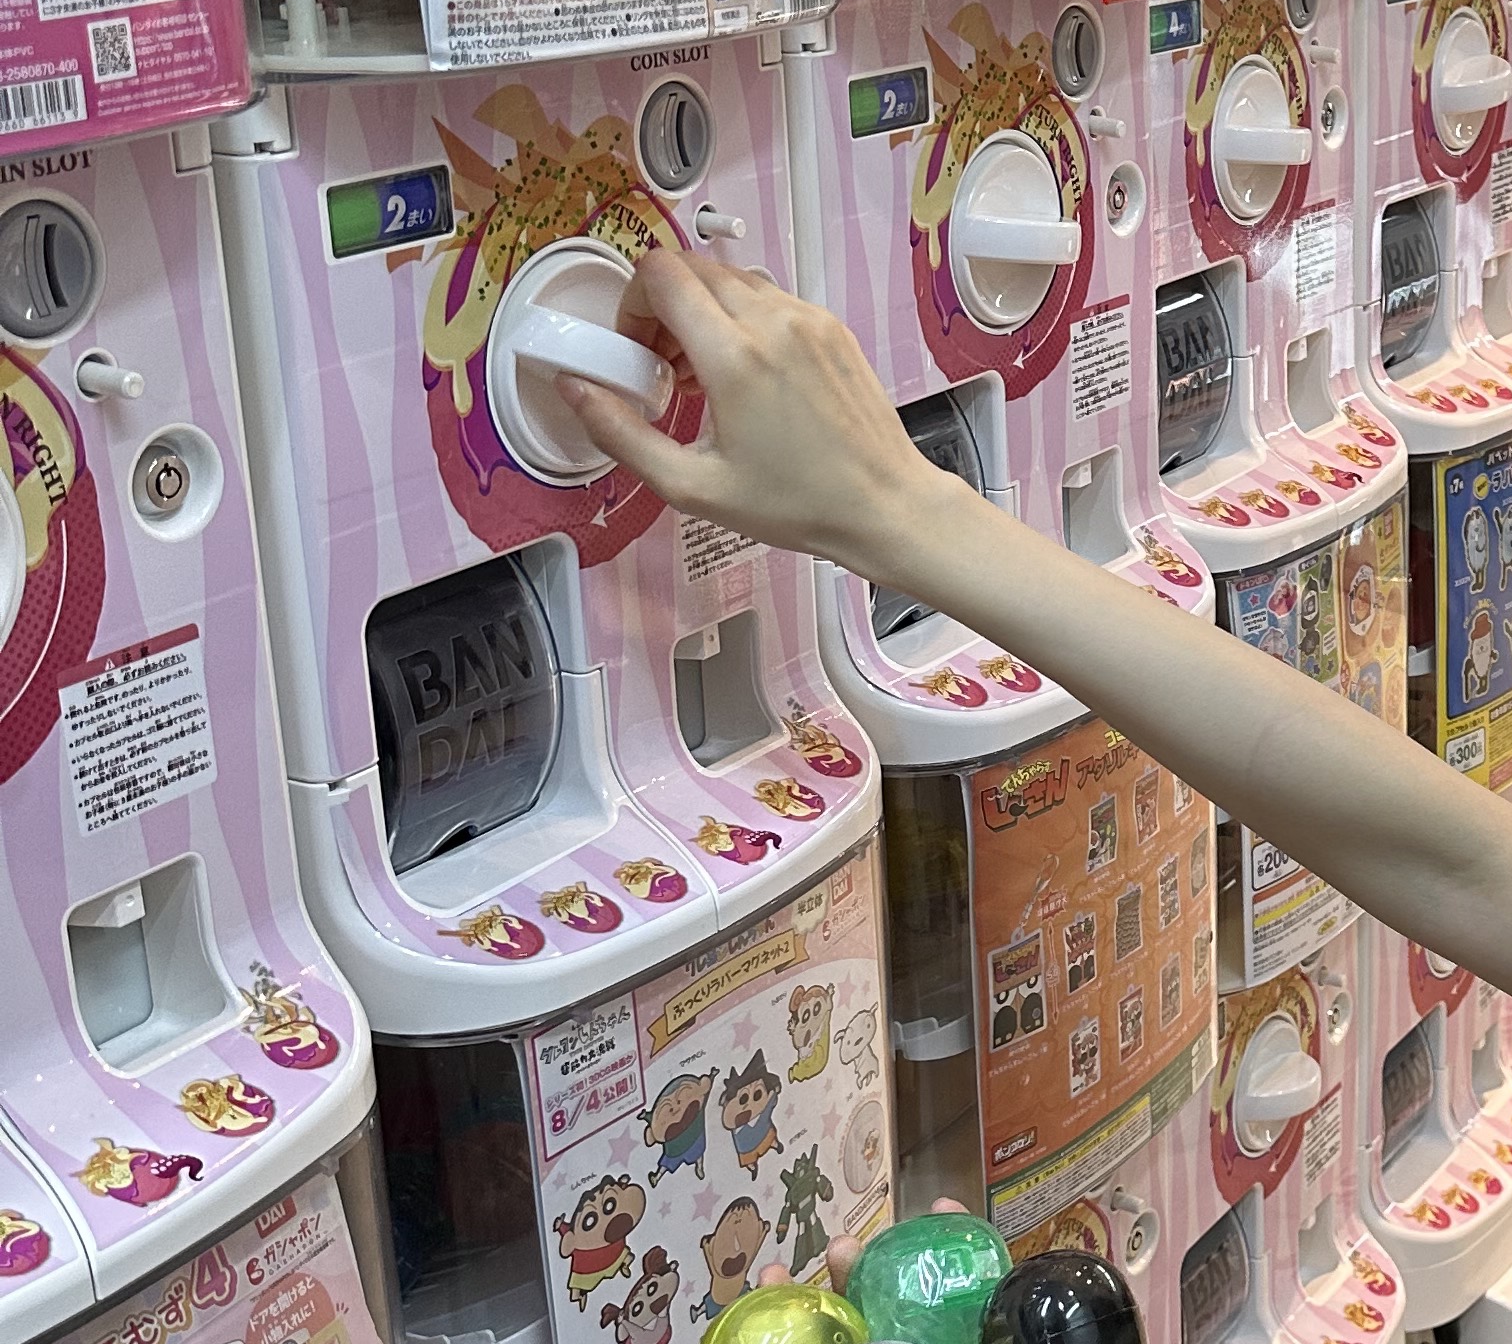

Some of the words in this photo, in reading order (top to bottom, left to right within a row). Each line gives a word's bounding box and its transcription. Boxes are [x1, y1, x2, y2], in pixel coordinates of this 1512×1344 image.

[630, 50, 672, 72] COIN
[673, 44, 712, 65] SLOT
[883, 88, 915, 122] 2まい
[32, 149, 95, 178] SLOT
[385, 193, 433, 234] 2まい
[614, 203, 660, 251] TURN
[12, 421, 69, 507] RIGHT
[121, 644, 151, 665] 注意
[397, 612, 535, 725] BAN
[416, 698, 520, 799] DAI
[797, 893, 824, 916] 半立体
[672, 941, 791, 1020] ぷっくりラバーマグネット2
[264, 1213, 323, 1262] ガシャポン
[249, 1276, 315, 1332] ドアを開けると
